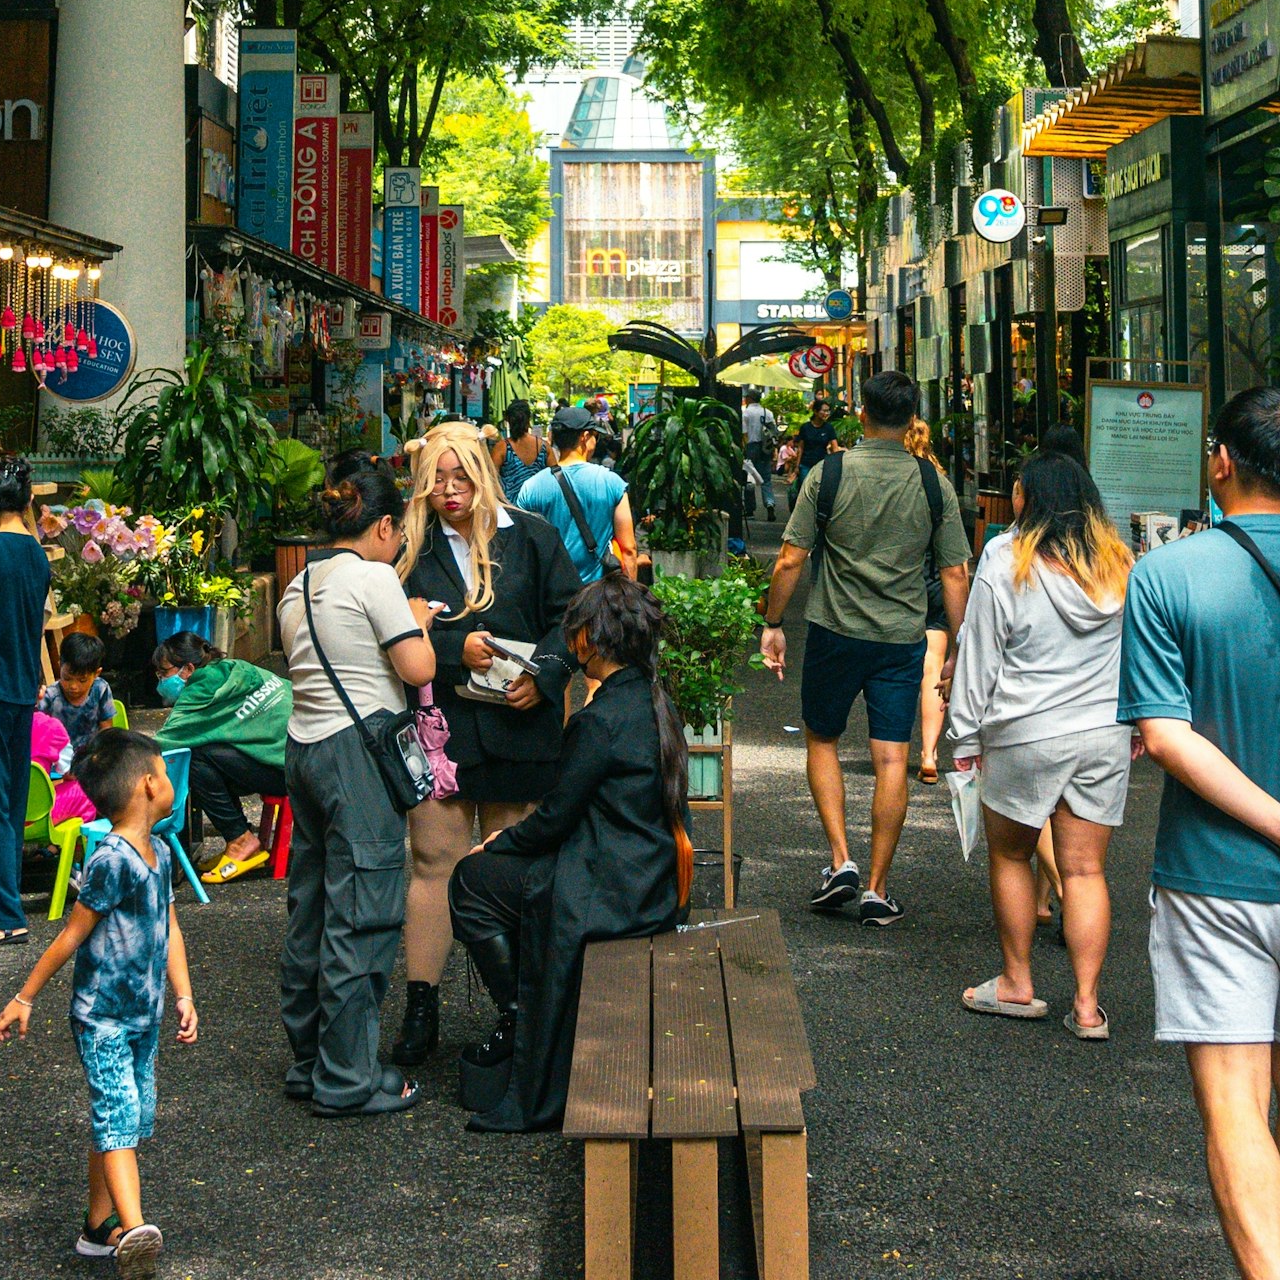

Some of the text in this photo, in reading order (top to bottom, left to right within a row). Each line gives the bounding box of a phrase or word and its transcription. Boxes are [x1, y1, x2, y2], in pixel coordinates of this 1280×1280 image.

[298, 122, 317, 140] A
[322, 122, 330, 162] COMPANY
[322, 164, 330, 188] STOCK
[321, 211, 329, 247] CULTURAL
[389, 211, 403, 232] TRẺ
[389, 235, 403, 259] BẢN
[388, 261, 403, 289] XUẤT
[442, 231, 454, 306] alphabooks
[83, 359, 119, 374] EDUCATION
[99, 348, 125, 363] SEN
